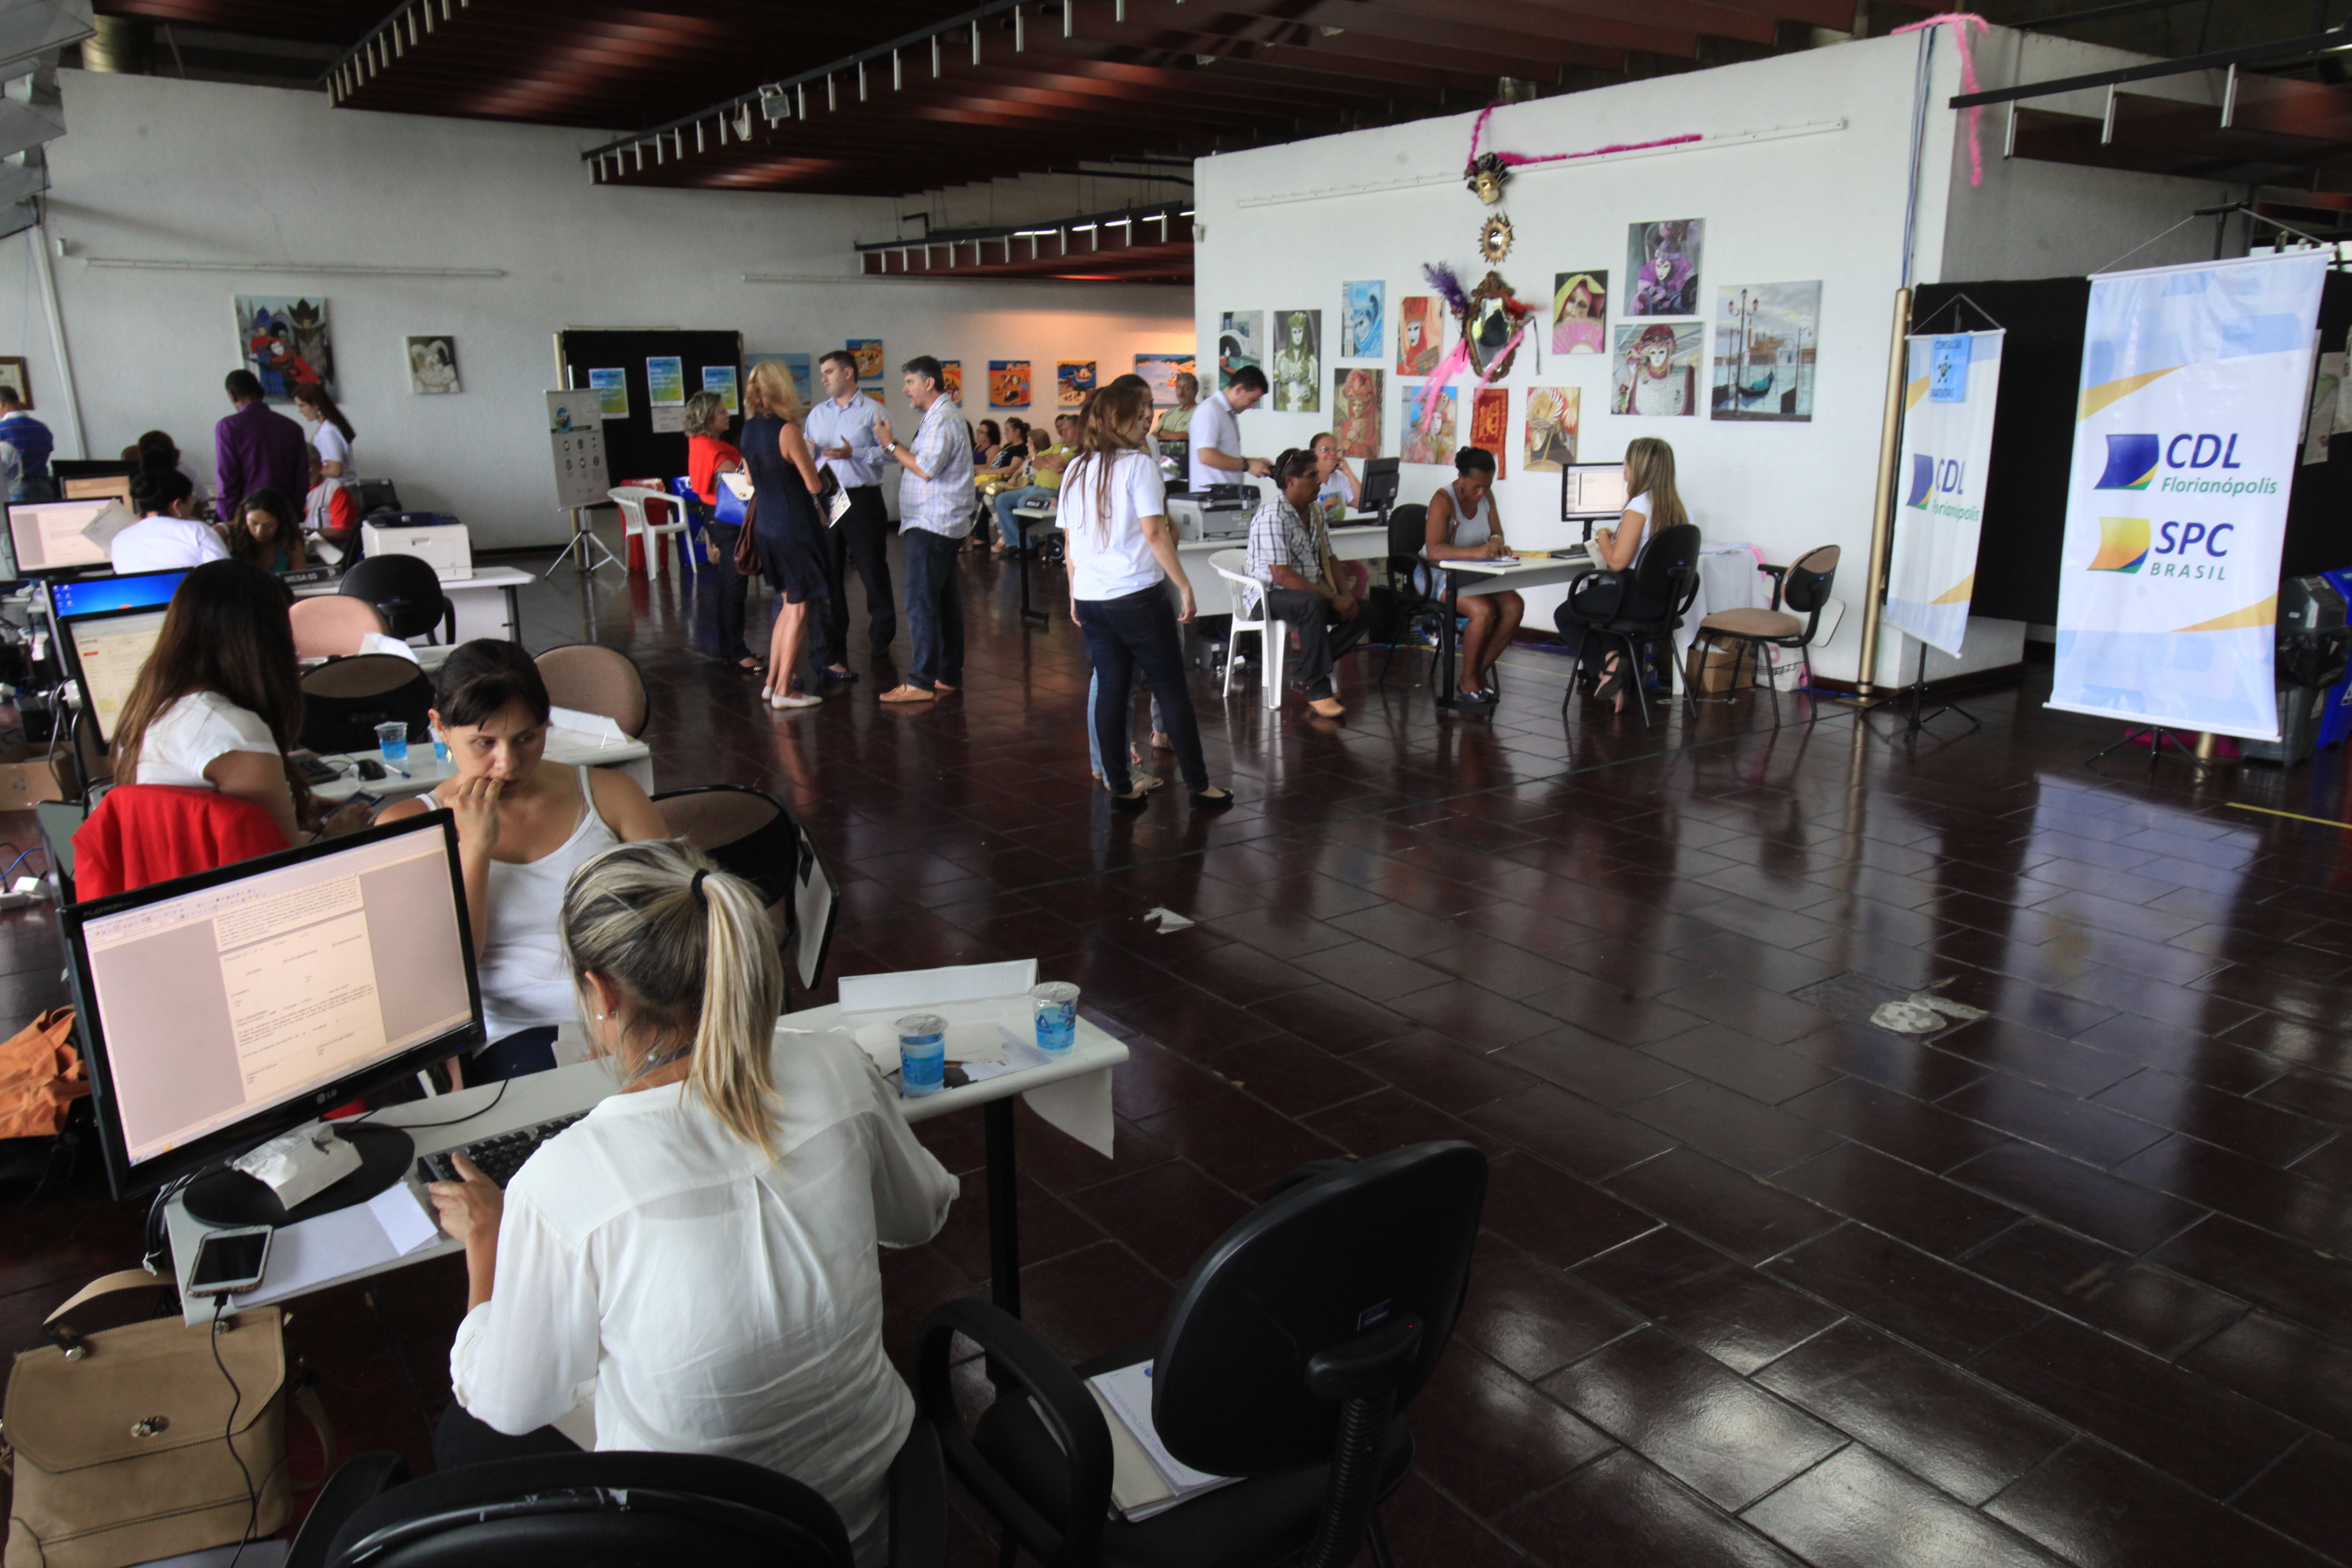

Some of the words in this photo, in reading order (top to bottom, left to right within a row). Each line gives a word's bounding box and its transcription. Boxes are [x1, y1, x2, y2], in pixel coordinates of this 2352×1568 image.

[2166, 433, 2242, 469] CDL
[1936, 458, 1966, 495] CDL
[2161, 476, 2278, 497] Florianópolis
[2155, 521, 2234, 557] SPC
[2150, 562, 2226, 580] BRASIL
[326, 1088, 337, 1098] LG
